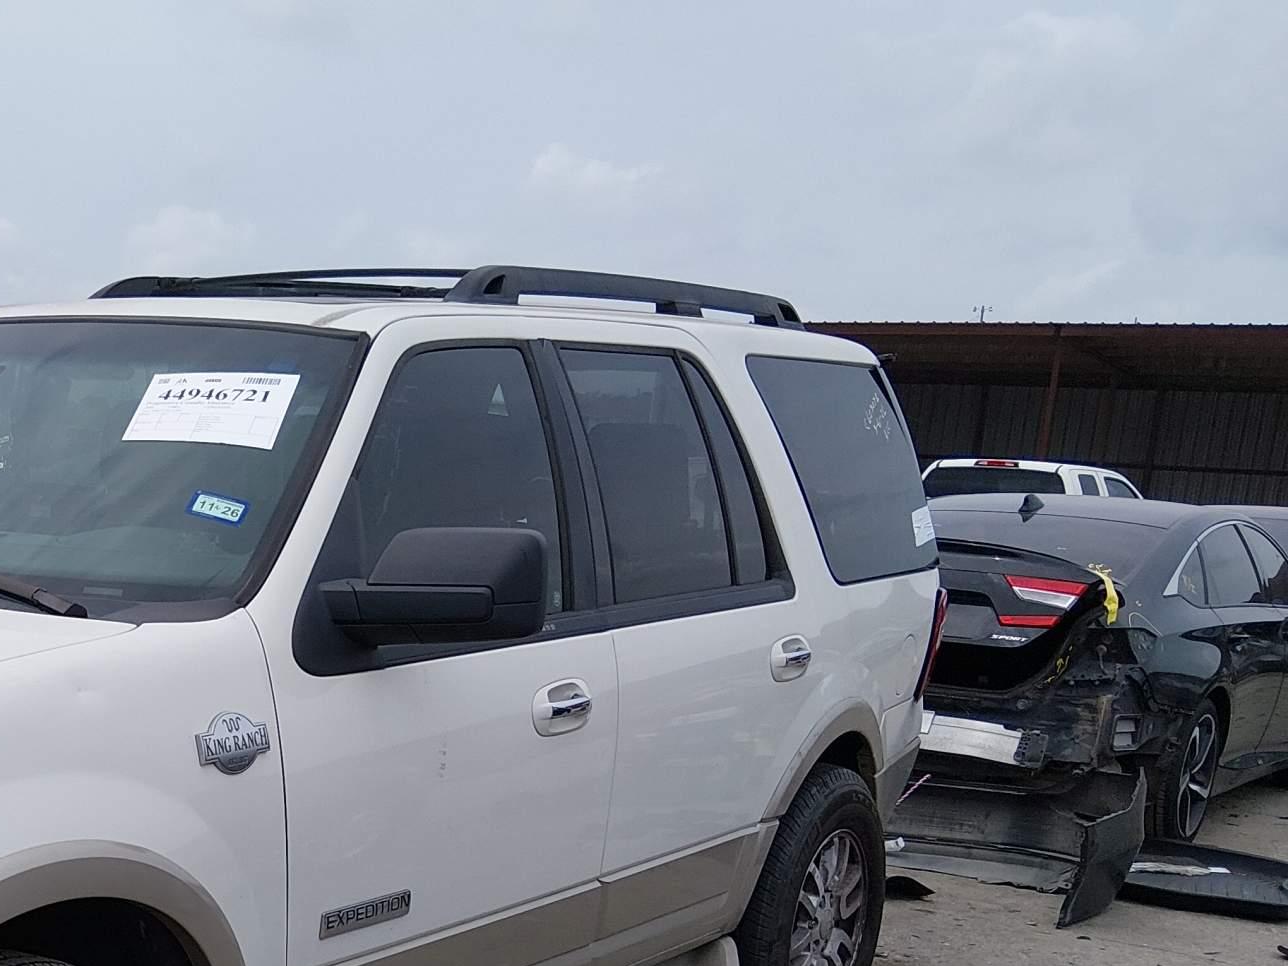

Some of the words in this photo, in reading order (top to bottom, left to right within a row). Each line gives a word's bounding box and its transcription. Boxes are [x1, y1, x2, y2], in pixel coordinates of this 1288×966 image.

[158, 388, 270, 403] 44946721
[204, 735, 232, 757] KING
[232, 727, 268, 752] RANCH
[326, 896, 411, 930] EXPEDITION
